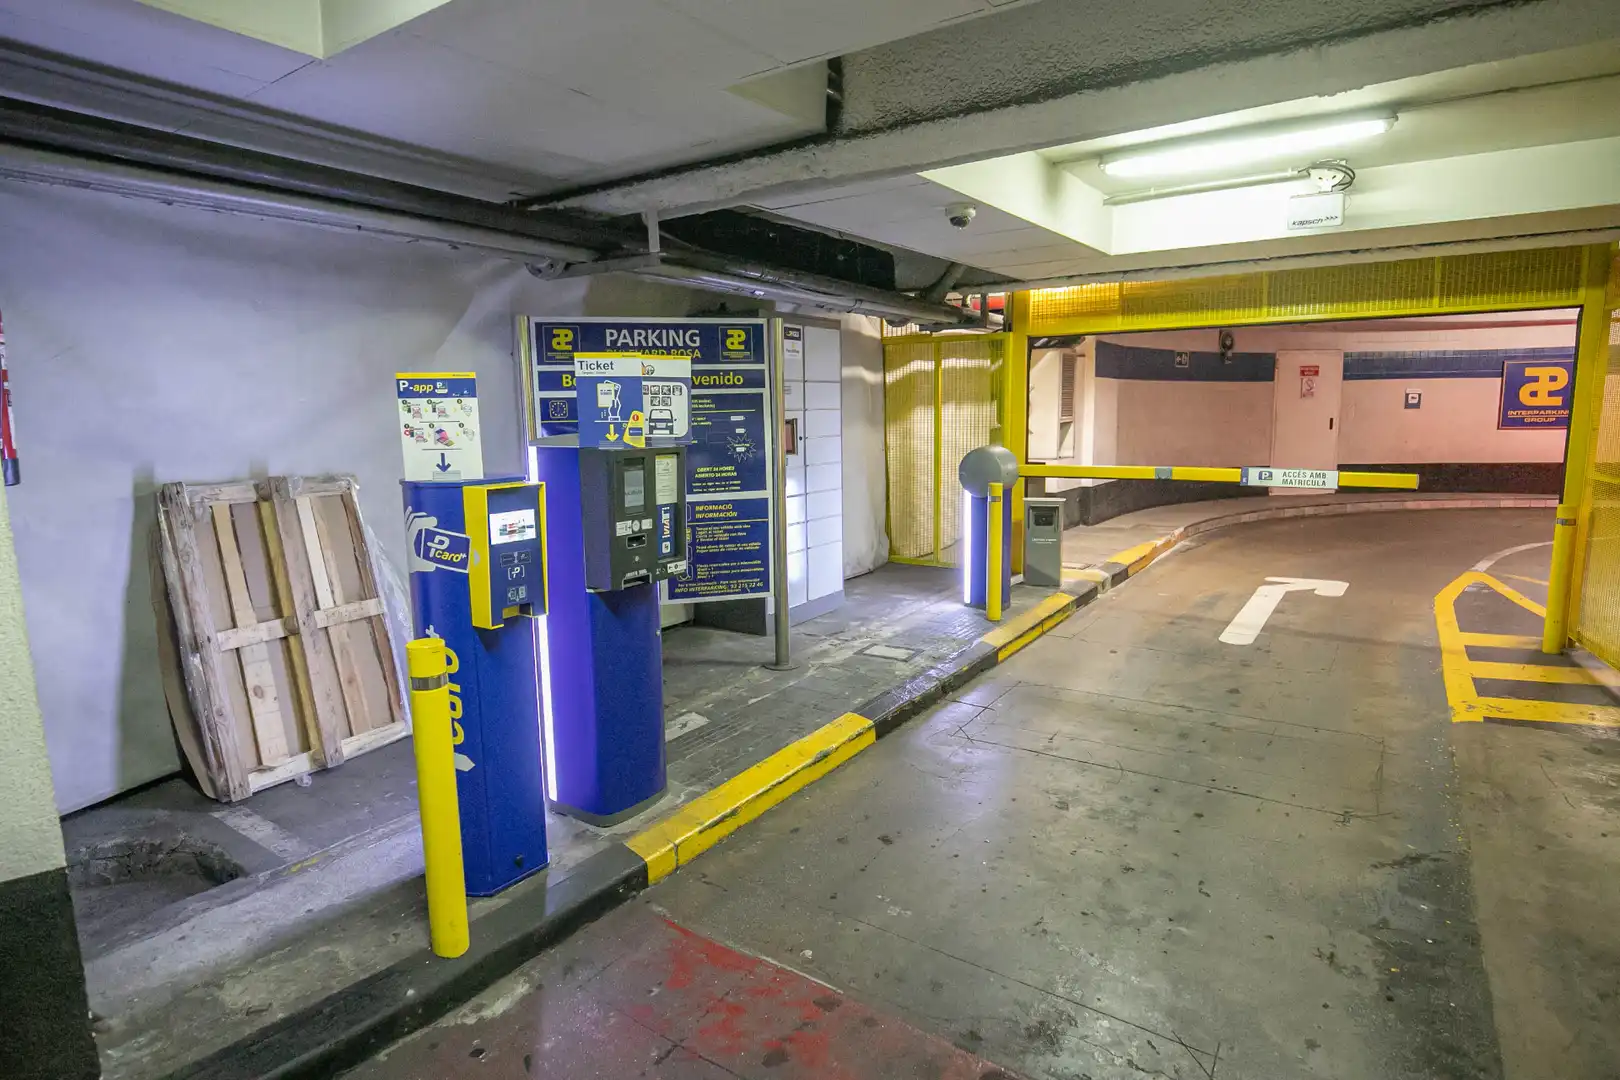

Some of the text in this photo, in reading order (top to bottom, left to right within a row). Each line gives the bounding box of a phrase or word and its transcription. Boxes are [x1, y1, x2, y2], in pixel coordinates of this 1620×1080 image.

[1292, 217, 1323, 226] kapsch
[605, 329, 700, 347] PARKING
[671, 348, 701, 358] ROSA
[577, 360, 614, 371] Ticket
[692, 372, 743, 385] venido
[399, 380, 433, 394] P-app
[1282, 479, 1326, 487] MATRICULA
